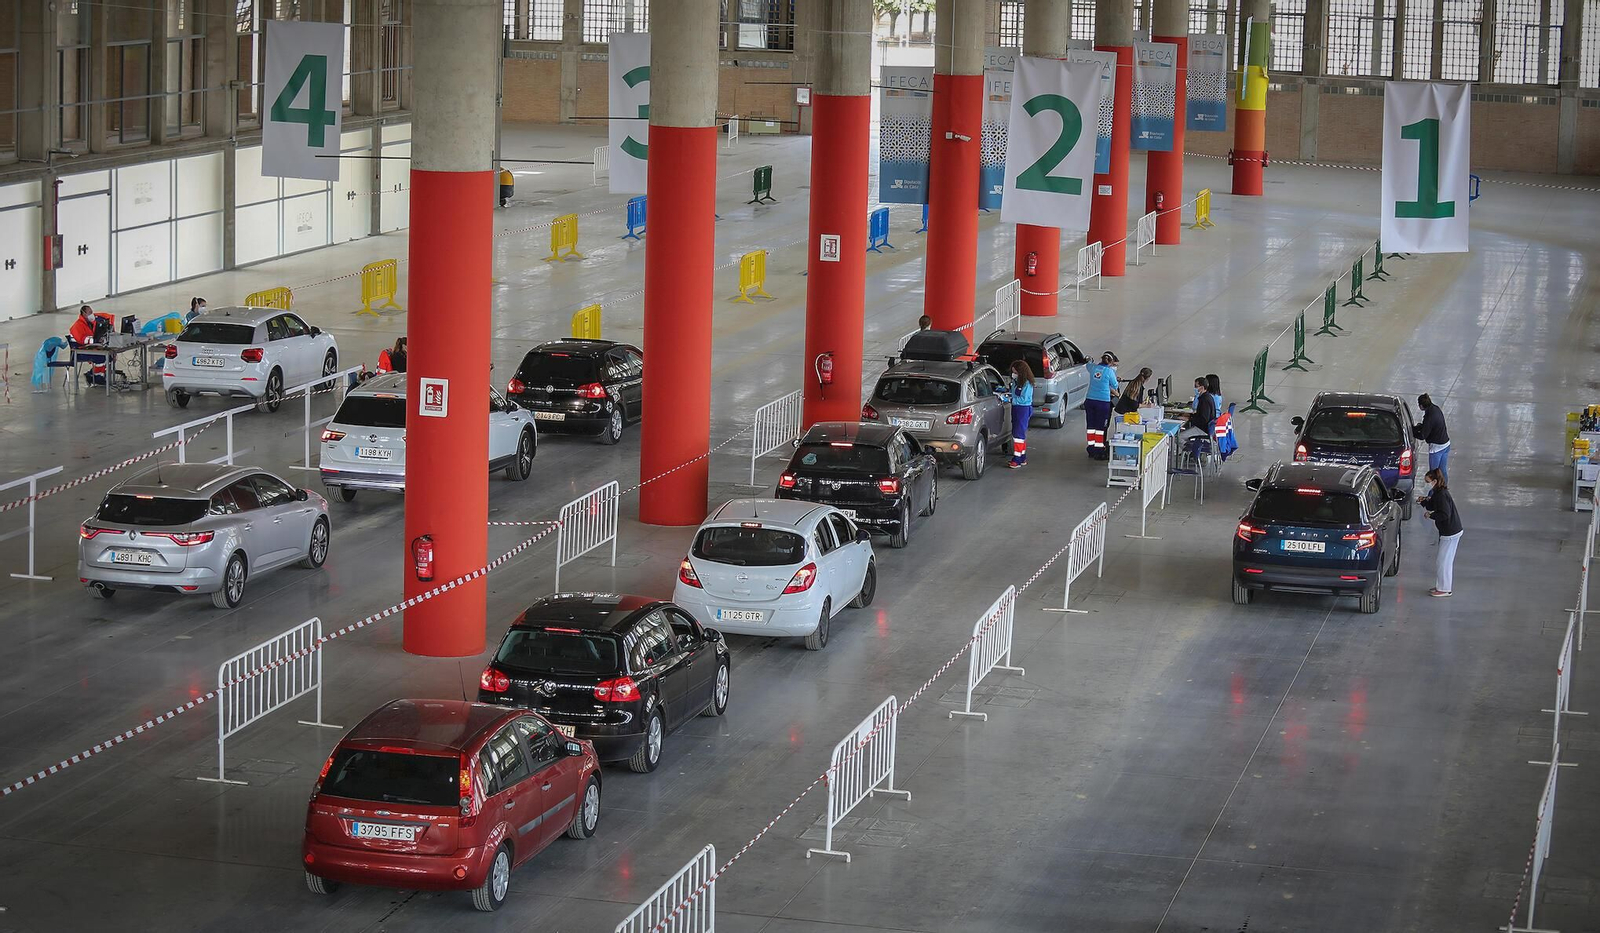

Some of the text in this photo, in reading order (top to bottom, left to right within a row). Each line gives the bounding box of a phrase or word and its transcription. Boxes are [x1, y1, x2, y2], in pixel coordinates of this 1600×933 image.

[1137, 49, 1173, 60] IFECA
[885, 76, 929, 88] IFECA
[270, 54, 336, 147] 4
[1015, 93, 1083, 196] 2
[1394, 118, 1456, 219] 1
[360, 448, 392, 458] 1198 KYH
[1286, 541, 1323, 551] 2510 LFL
[115, 554, 152, 564] 4891 KHC
[723, 610, 761, 621] 1125 GTR
[360, 824, 413, 839] 3795 FFS
